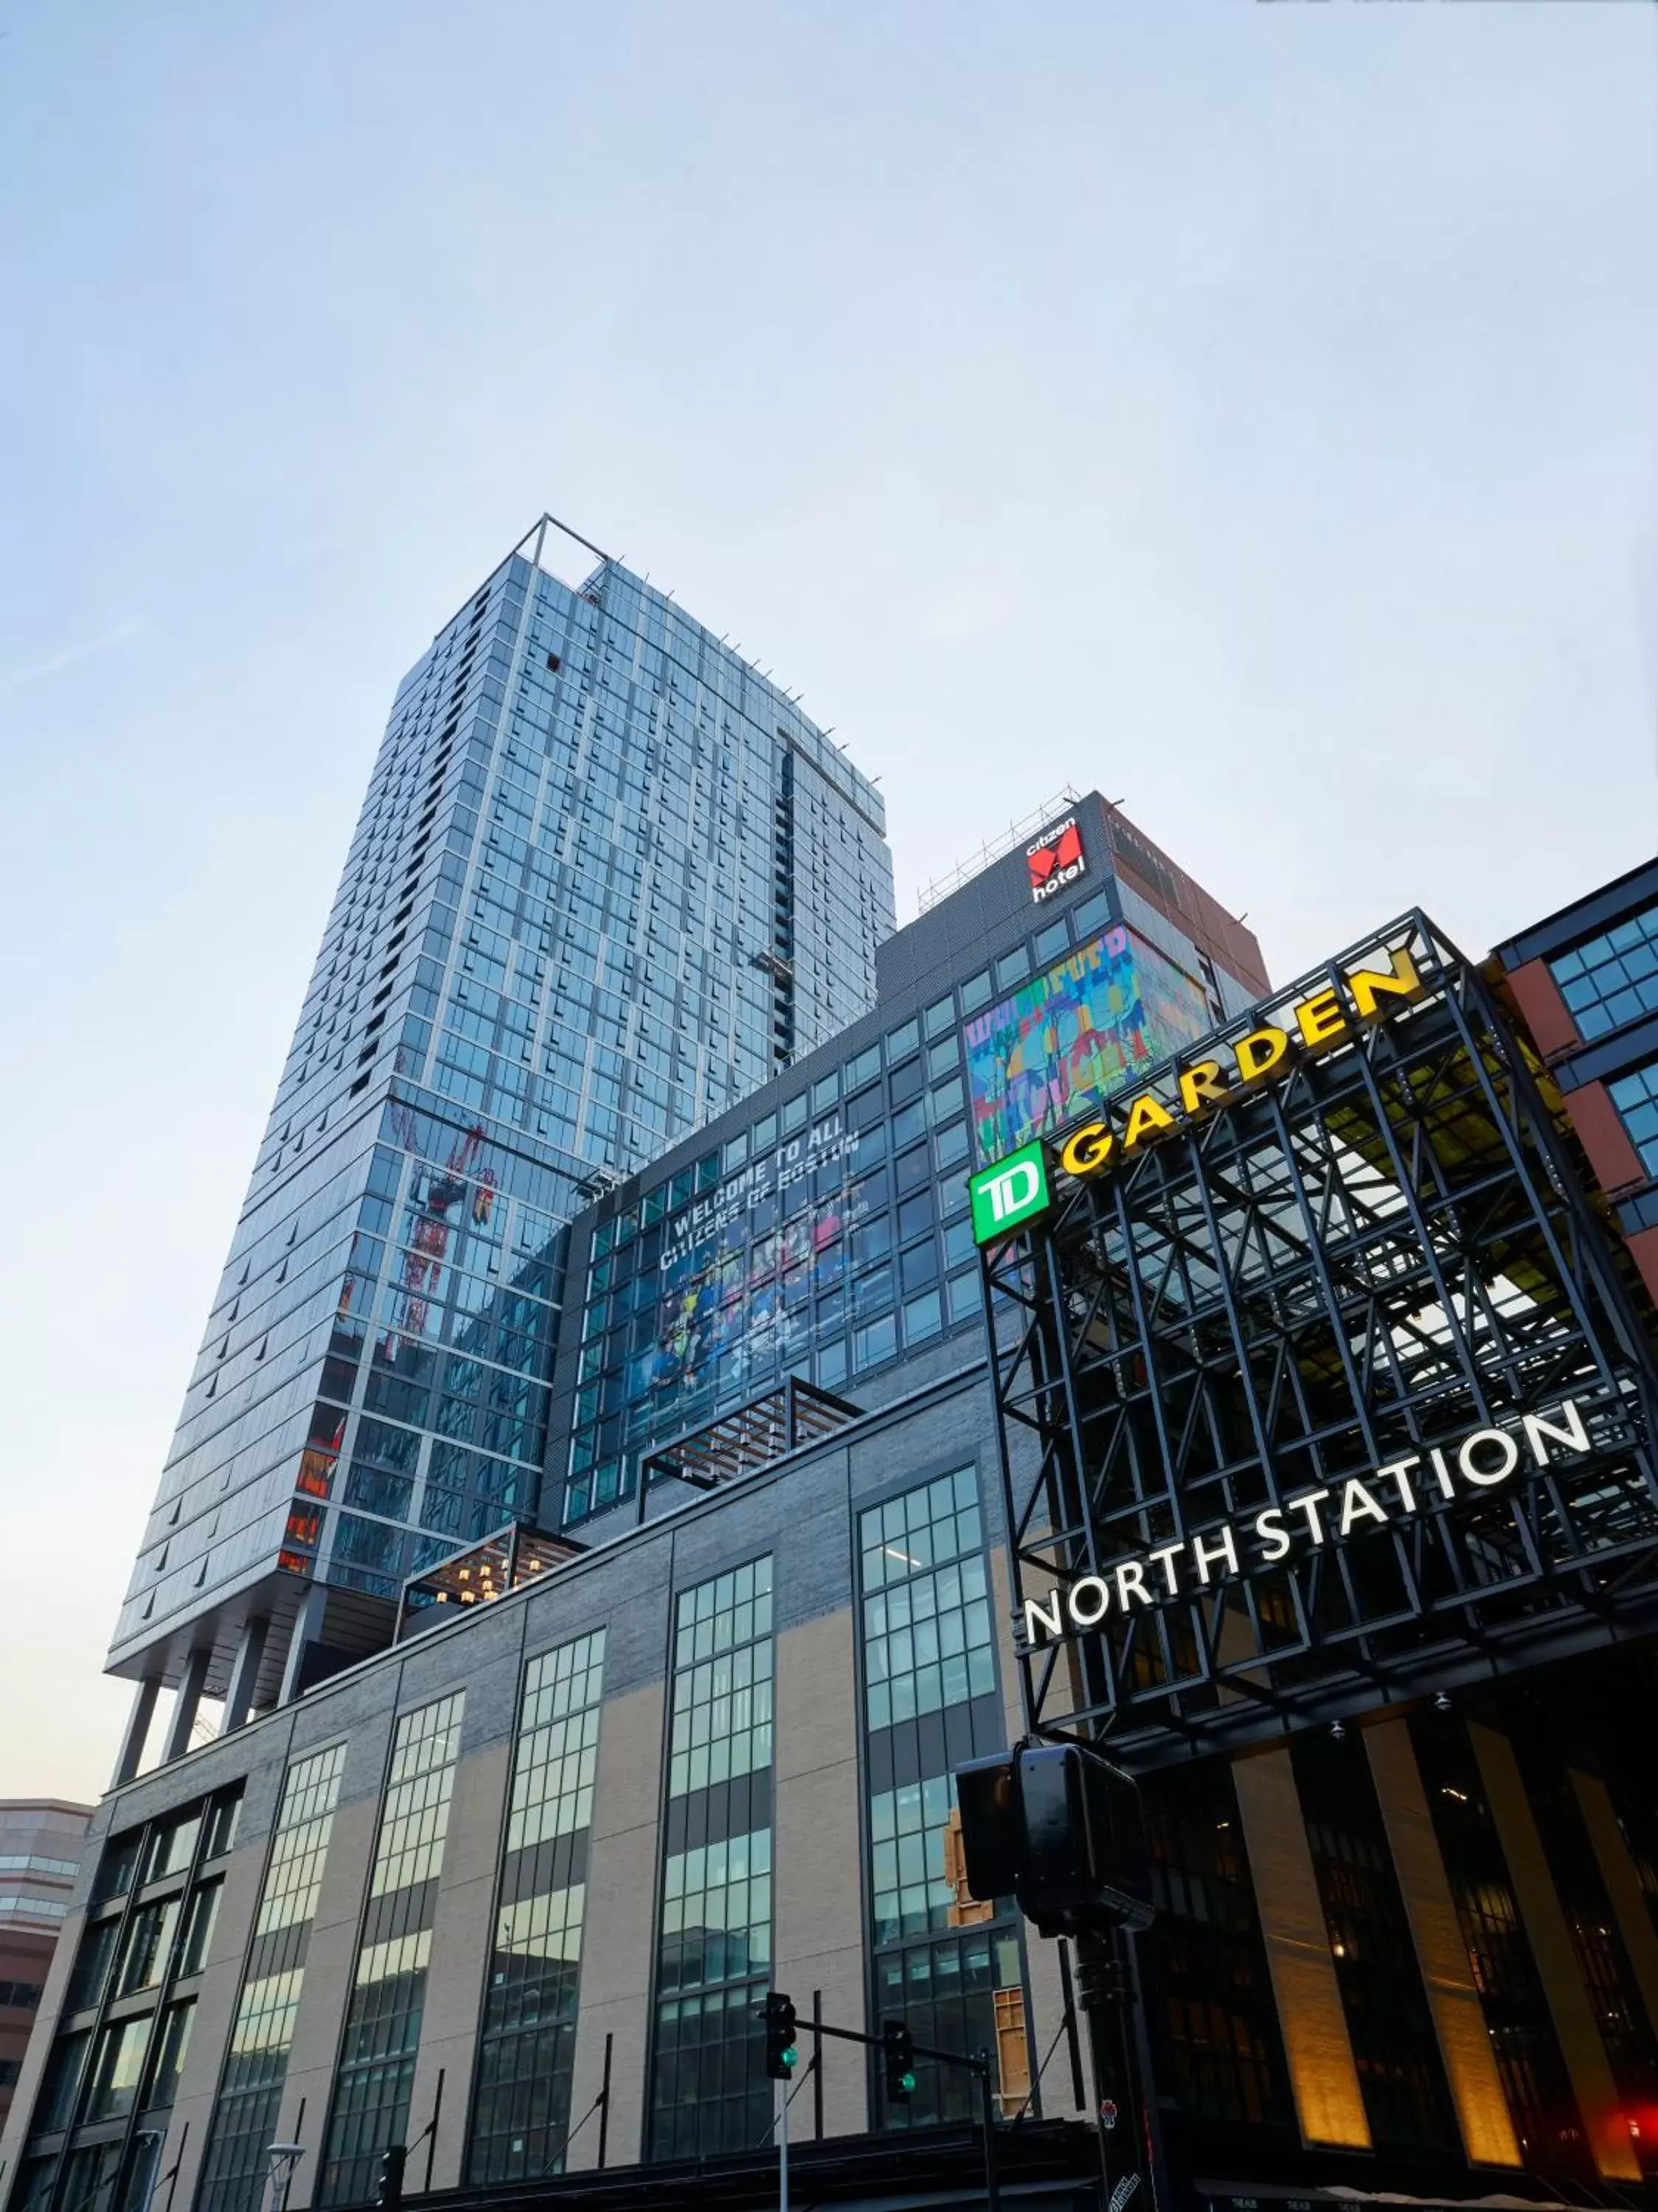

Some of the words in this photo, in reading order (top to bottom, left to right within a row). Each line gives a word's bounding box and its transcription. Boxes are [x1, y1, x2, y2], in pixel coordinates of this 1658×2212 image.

[1027, 818, 1076, 856] citizen
[1032, 855, 1086, 902] hotel
[977, 1158, 1039, 1222] TD
[1062, 948, 1424, 1177] GARDEN
[660, 1201, 740, 1270] CITIZENS
[747, 1181, 771, 1209] OF
[778, 1130, 860, 1191] BOSTON
[675, 1161, 766, 1237] WELCOME
[776, 1141, 800, 1167] TO
[808, 1116, 843, 1149] ALL
[1024, 1525, 1239, 1645] NORTH
[1255, 1399, 1592, 1561] STATION
